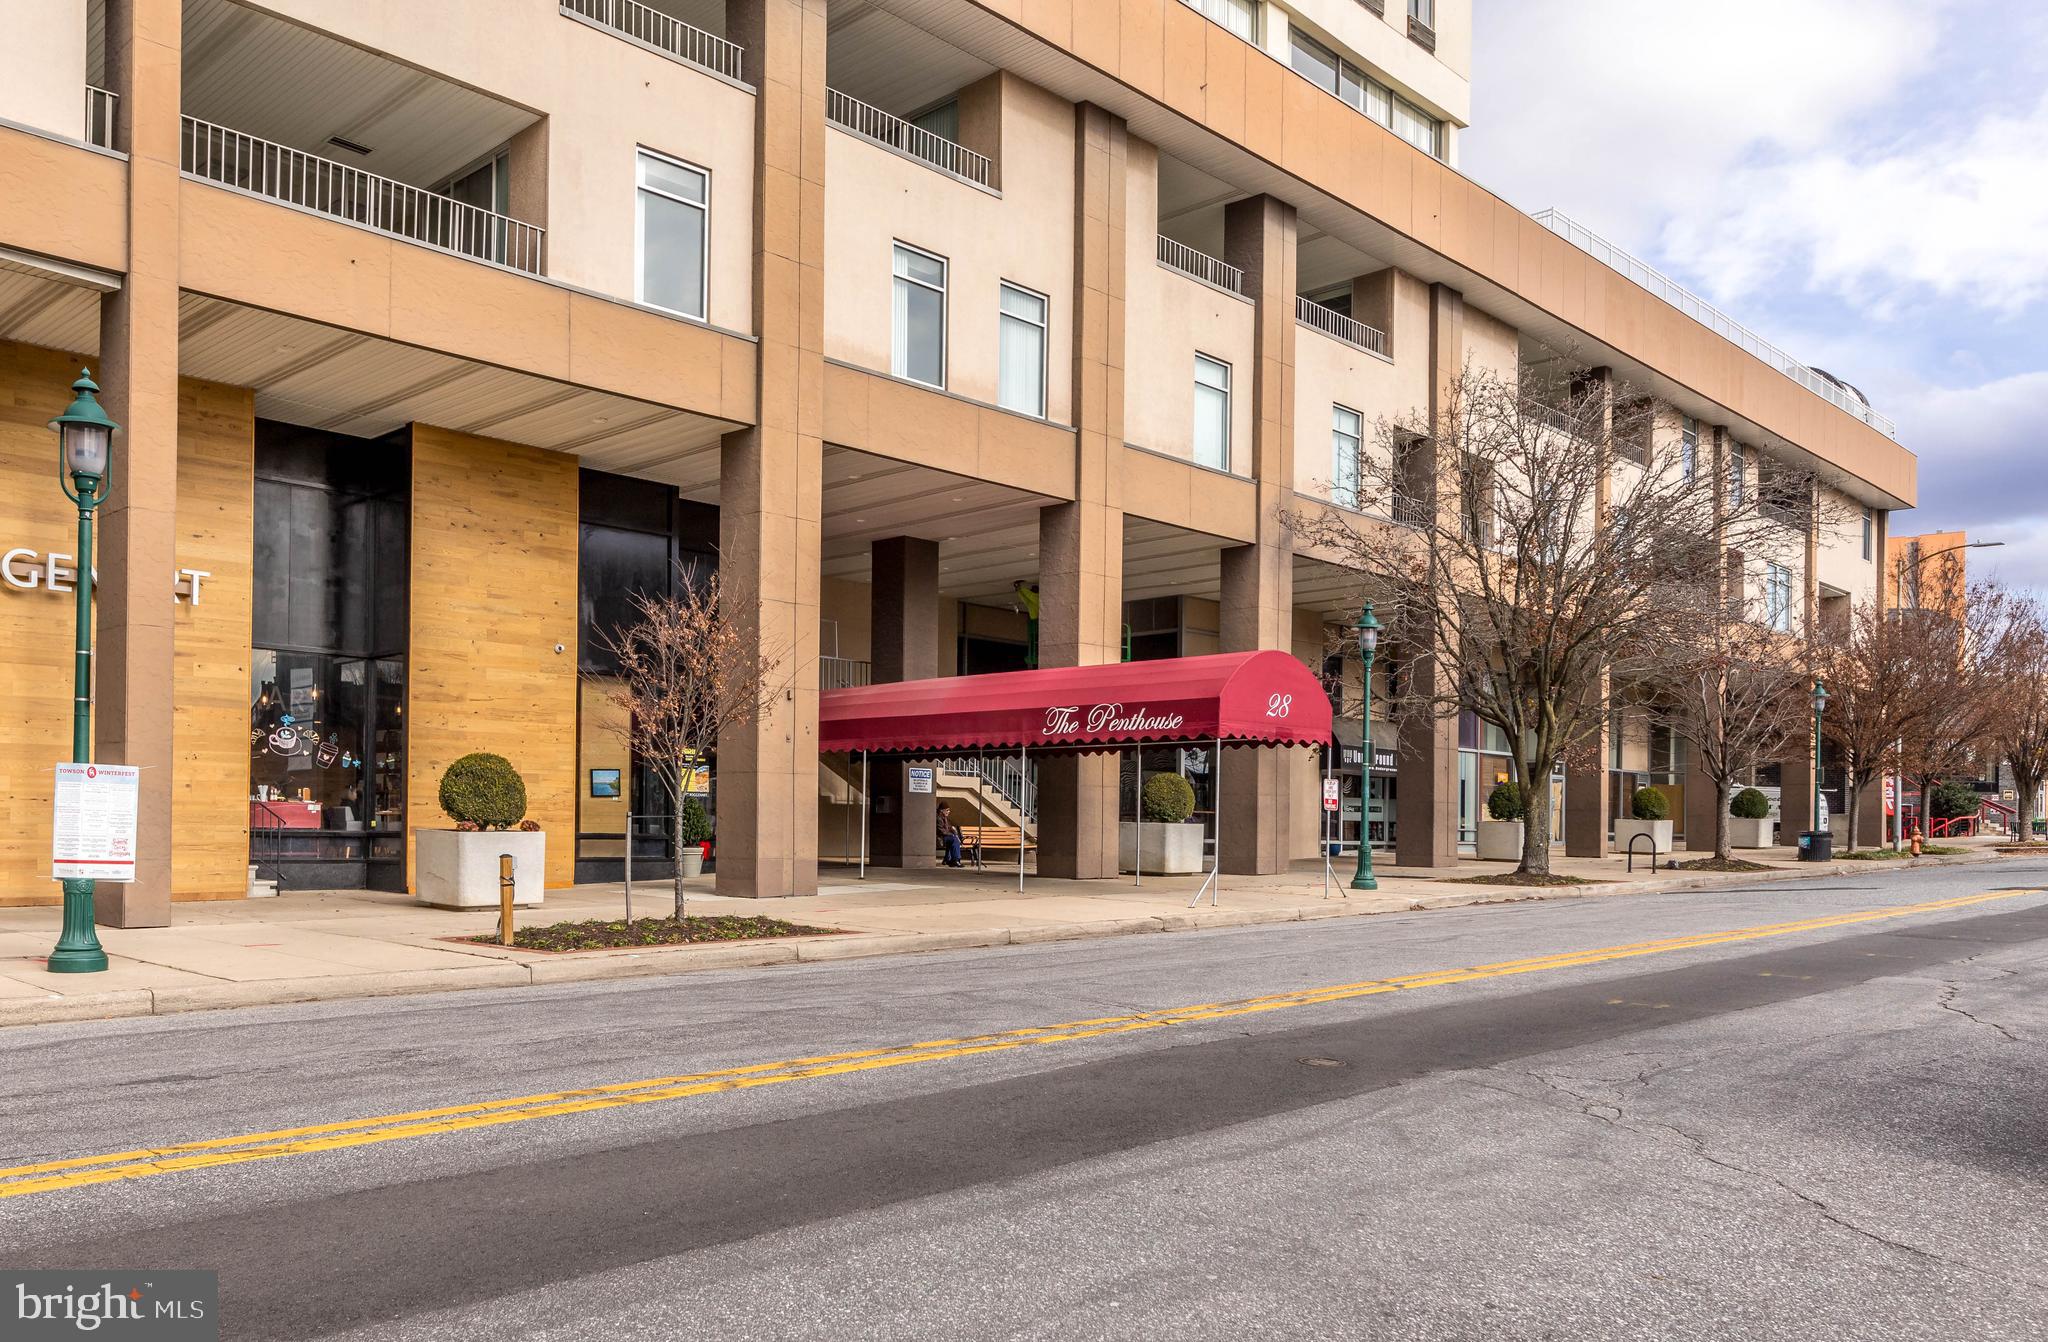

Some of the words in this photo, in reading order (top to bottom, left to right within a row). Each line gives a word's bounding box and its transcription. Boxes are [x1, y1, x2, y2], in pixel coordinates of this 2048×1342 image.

[1042, 706, 1079, 735] The
[1087, 702, 1183, 733] Penthouse
[1266, 693, 1292, 718] 28
